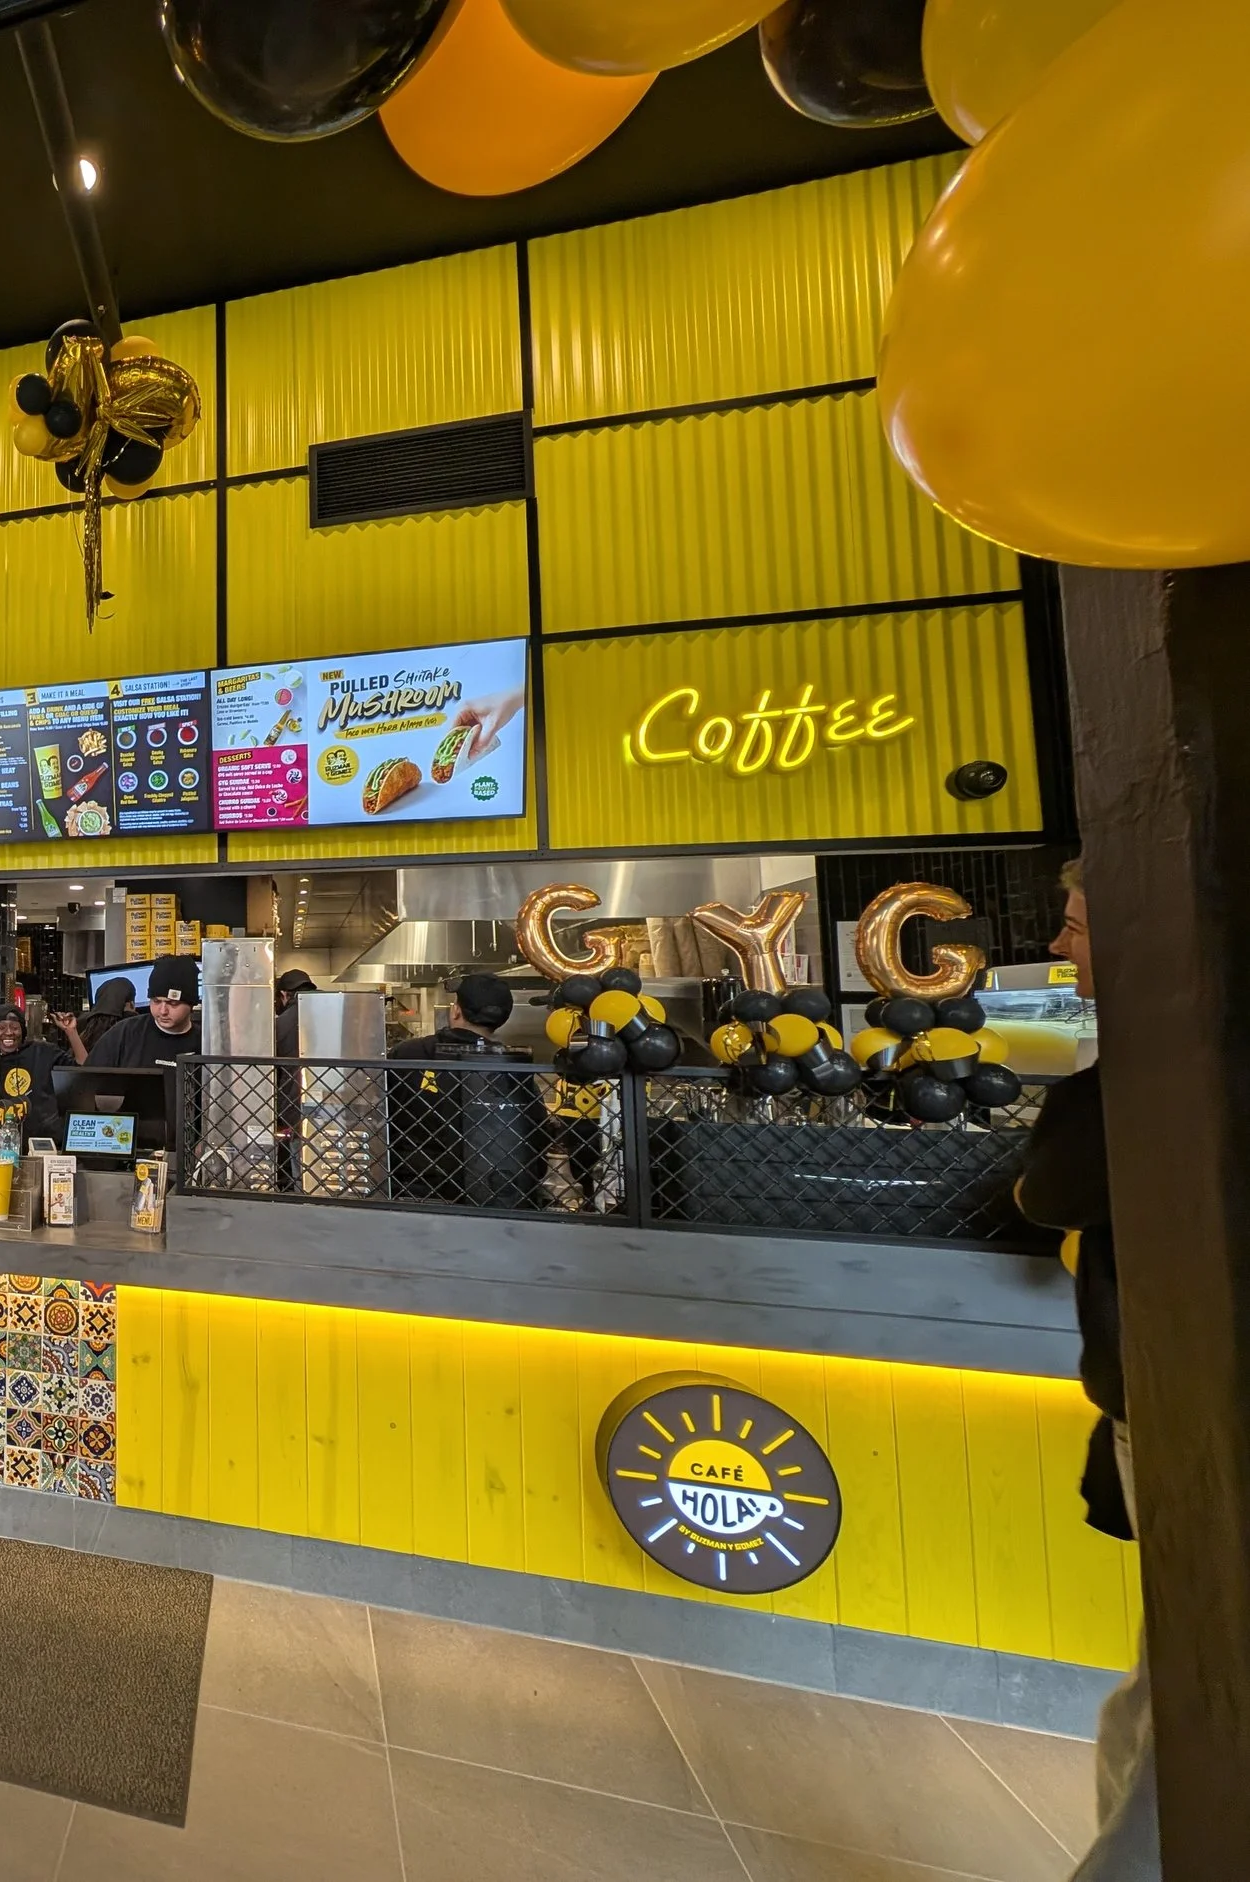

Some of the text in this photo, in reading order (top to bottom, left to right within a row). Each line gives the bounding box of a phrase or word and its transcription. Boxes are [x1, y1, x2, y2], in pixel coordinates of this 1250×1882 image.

[217, 673, 260, 687] MARGARITAS
[322, 670, 342, 680] NEW
[111, 684, 120, 696] 4
[125, 684, 142, 692] SALSA
[224, 683, 246, 693] BEERS
[330, 675, 389, 695] PULLED
[26, 692, 36, 704] 3
[70, 689, 85, 697] MEAL
[142, 698, 155, 706] FREE
[114, 707, 148, 715] CUSTOMIZE
[636, 684, 916, 774] Coffee
[219, 752, 252, 763] DESSERTS
[516, 882, 986, 998] G Y G
[53, 1184, 71, 1192] FREE
[137, 1216, 152, 1226] MENU
[690, 1462, 744, 1482] CAFÉ
[682, 1489, 762, 1528] HOLA!
[678, 1525, 764, 1551] BY GUZMAN Y GOMEZ
